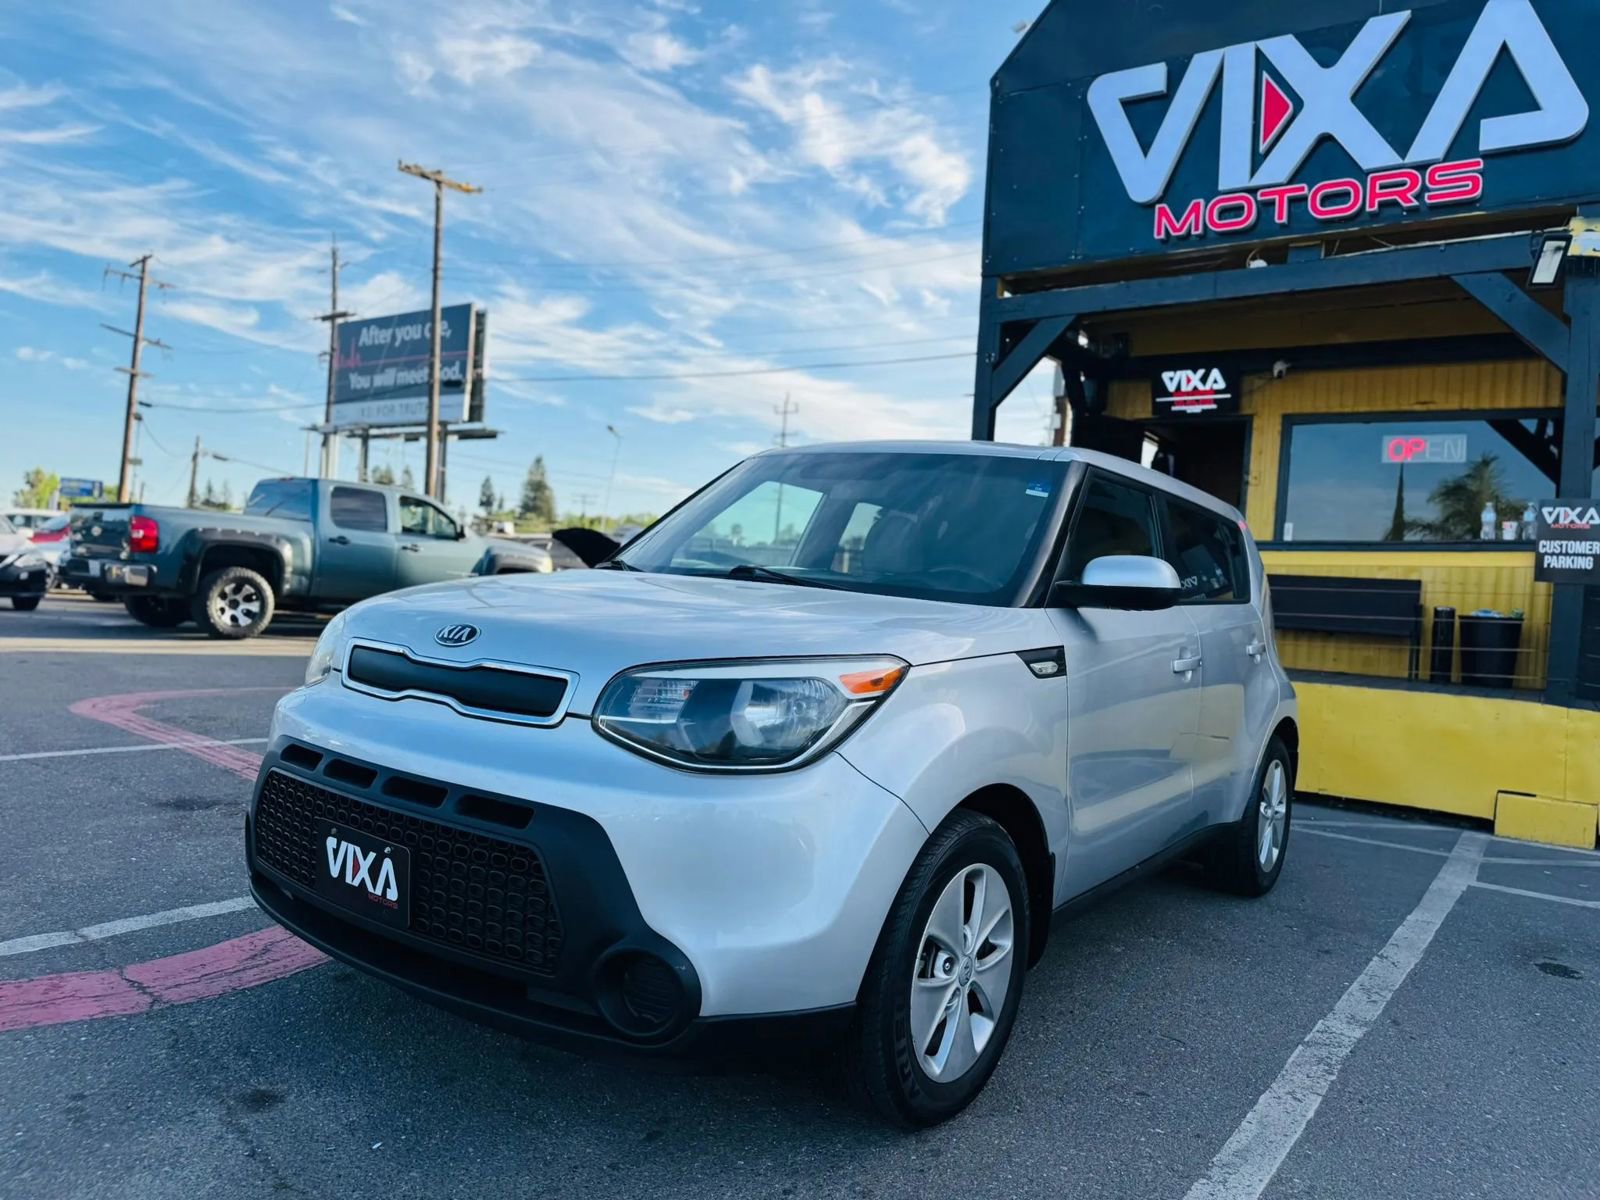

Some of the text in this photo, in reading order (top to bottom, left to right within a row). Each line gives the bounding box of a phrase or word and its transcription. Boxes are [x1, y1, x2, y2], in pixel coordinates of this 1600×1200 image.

[1087, 0, 1590, 204] VIXA
[1153, 158, 1484, 240] MOTORS
[358, 324, 393, 347] After
[394, 323, 422, 347] you
[349, 372, 371, 390] You
[372, 366, 397, 388] will
[1161, 367, 1227, 393] VIXA
[1387, 437, 1463, 462] OPEN
[1541, 506, 1600, 525] VIXA
[1538, 540, 1600, 555] CUSTOMER
[1543, 555, 1594, 570] PARKING
[438, 625, 472, 641] KIA
[326, 836, 399, 902] VIXA
